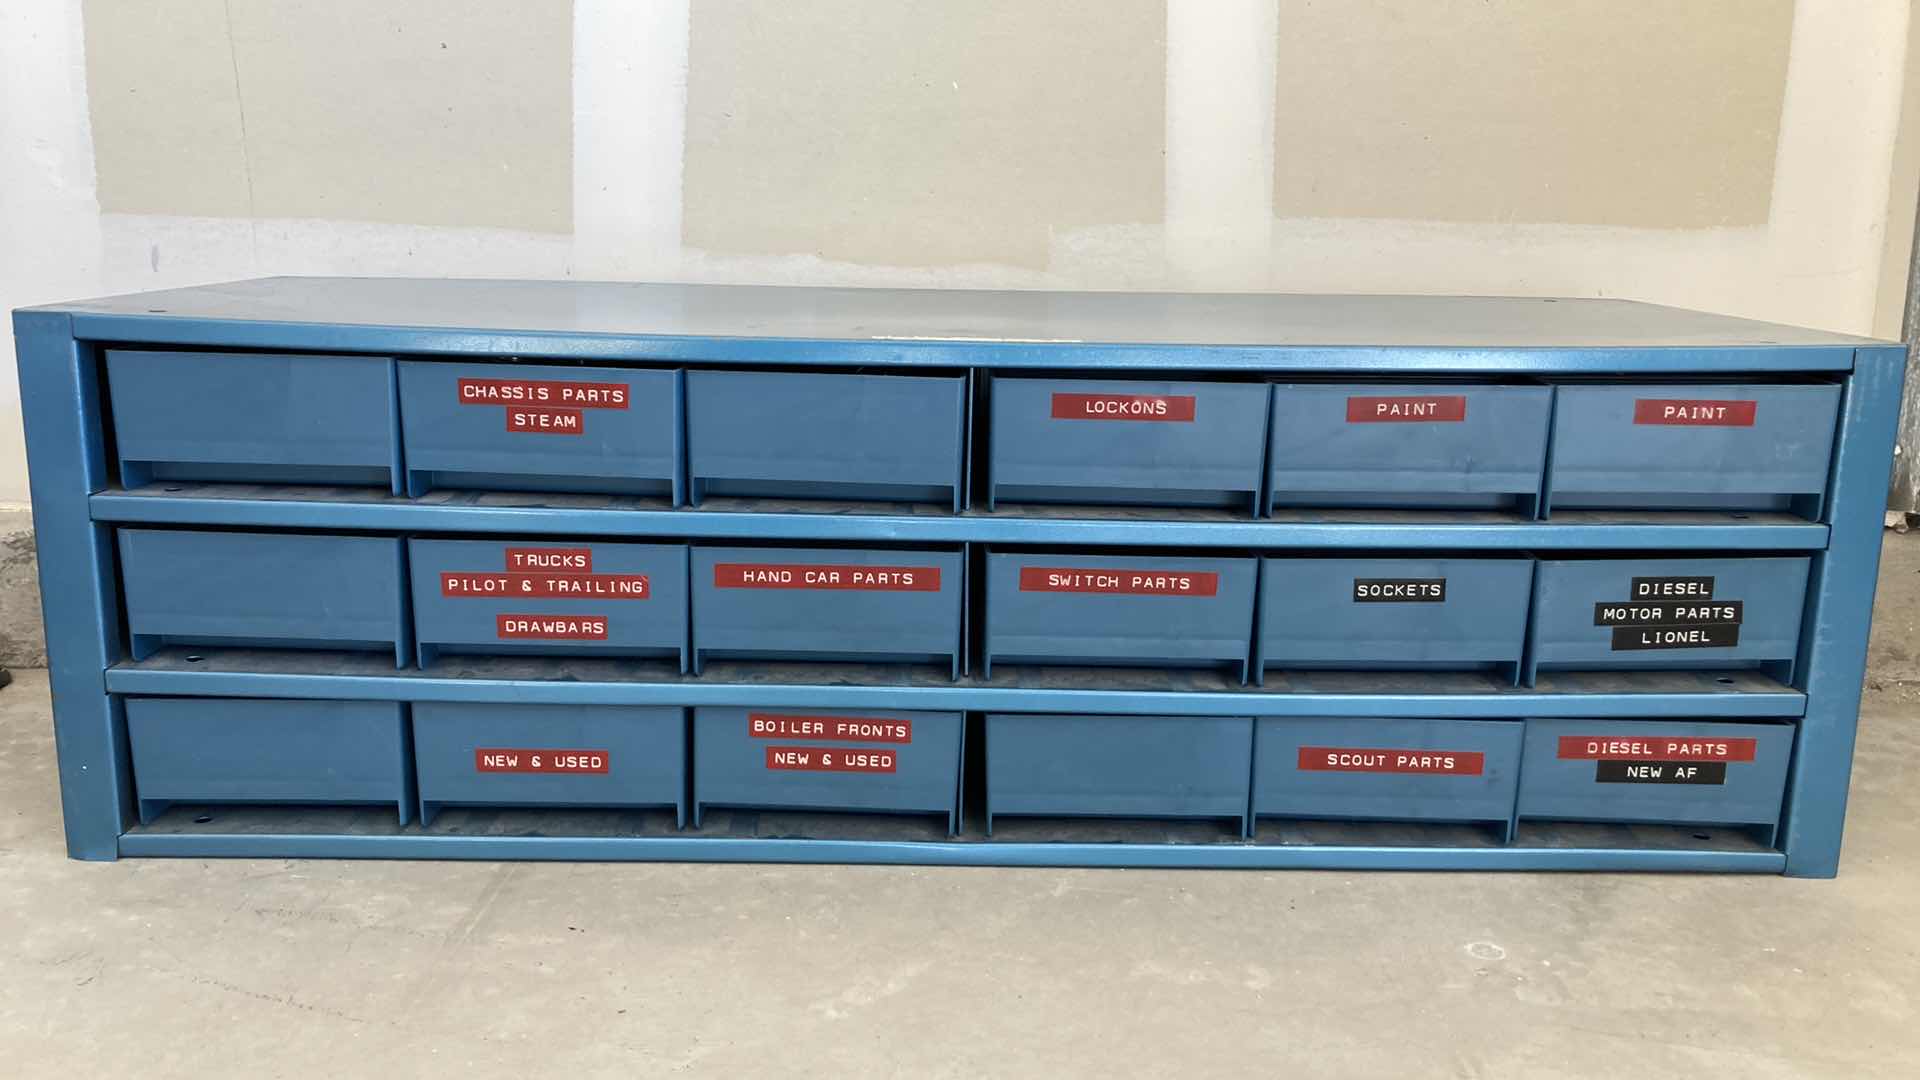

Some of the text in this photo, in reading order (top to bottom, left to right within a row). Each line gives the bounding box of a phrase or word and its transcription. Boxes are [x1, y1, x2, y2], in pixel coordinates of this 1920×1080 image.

[463, 385, 624, 403] CHASSIS PARTS
[1085, 399, 1168, 416] LOCKONS
[1375, 401, 1439, 418] PAINT
[1662, 404, 1728, 420] PAINT
[514, 413, 576, 428] STEAM
[513, 554, 586, 568] TRUCKS
[743, 570, 913, 585] HAND CAR PARTS
[1048, 574, 1191, 590] SWITCH PARTS
[448, 578, 643, 593] PILOT & TRAILING
[1356, 582, 1442, 598] SOCKETS
[1639, 582, 1709, 595] DIESEL
[1603, 606, 1735, 620] MOTOR PARTS
[505, 620, 604, 634] DRAWBARS
[1641, 630, 1710, 644] LIONEL
[753, 720, 906, 738] BOILER FRONTS
[1586, 741, 1729, 757] DIESEL PARTS
[484, 755, 602, 769] NEW & USED
[774, 752, 892, 768] NEW & USED
[1327, 753, 1455, 769] SCOUT PARTS
[1627, 766, 1697, 779] NEW AF
